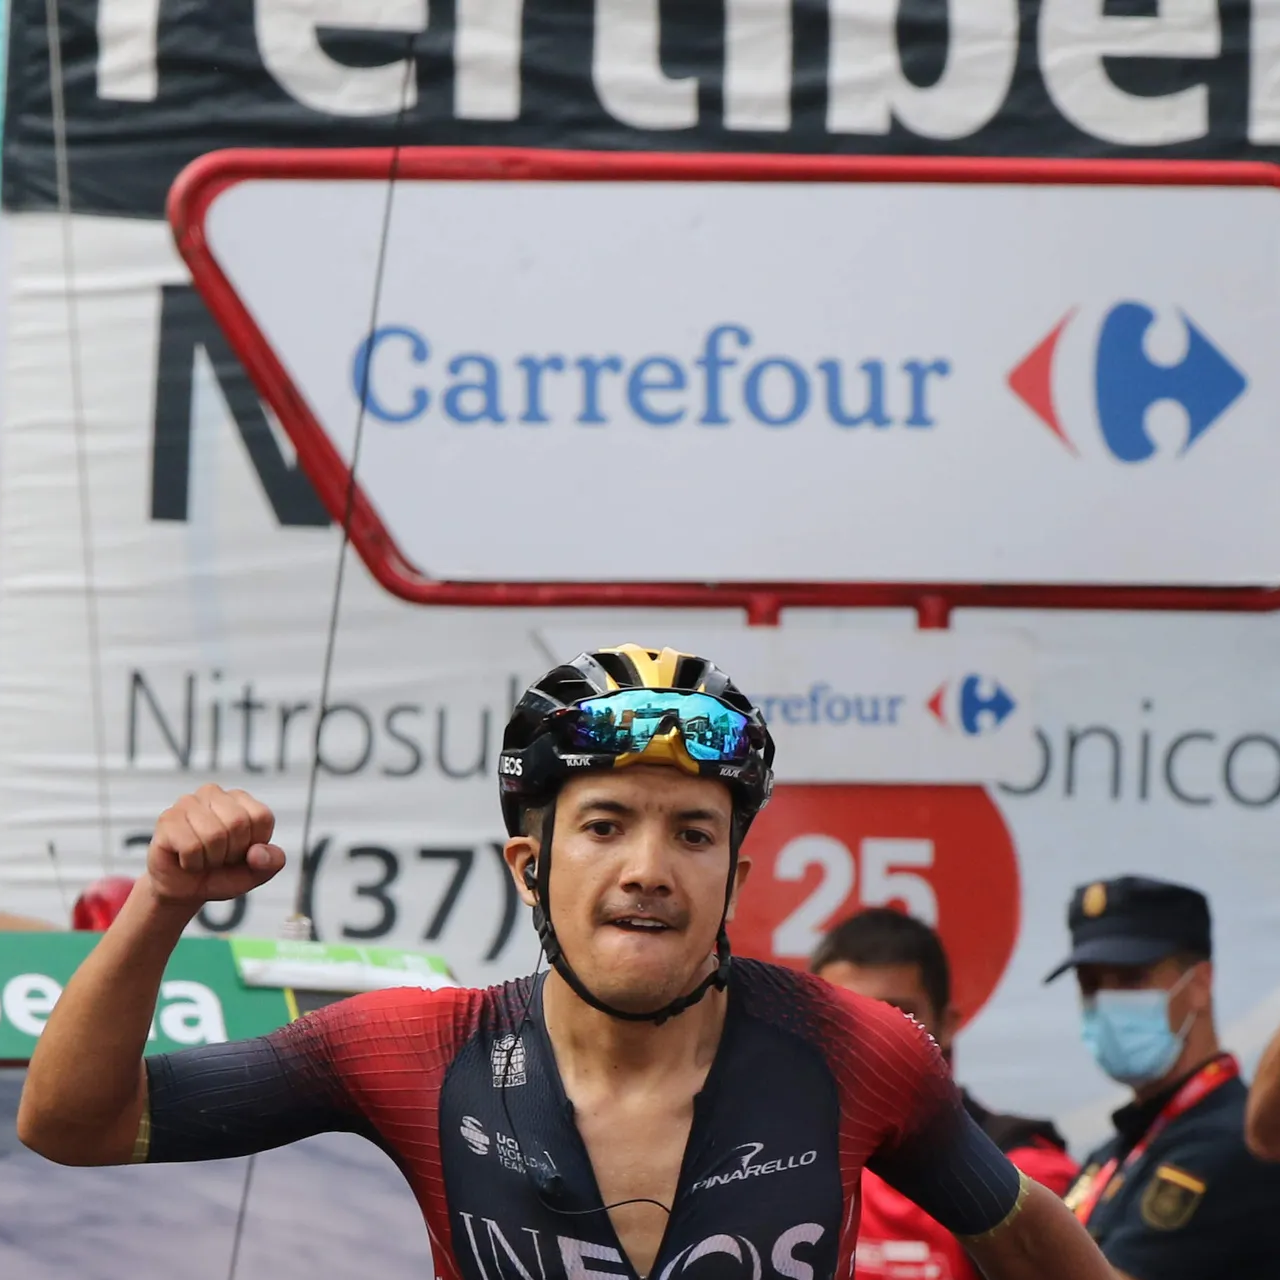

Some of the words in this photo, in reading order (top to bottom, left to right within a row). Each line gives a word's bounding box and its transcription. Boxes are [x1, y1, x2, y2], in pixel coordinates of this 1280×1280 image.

[352, 325, 951, 429] Carrefour
[771, 834, 940, 958] 25
[496, 1132, 519, 1150] UCI
[692, 1150, 817, 1194] PINARELLO
